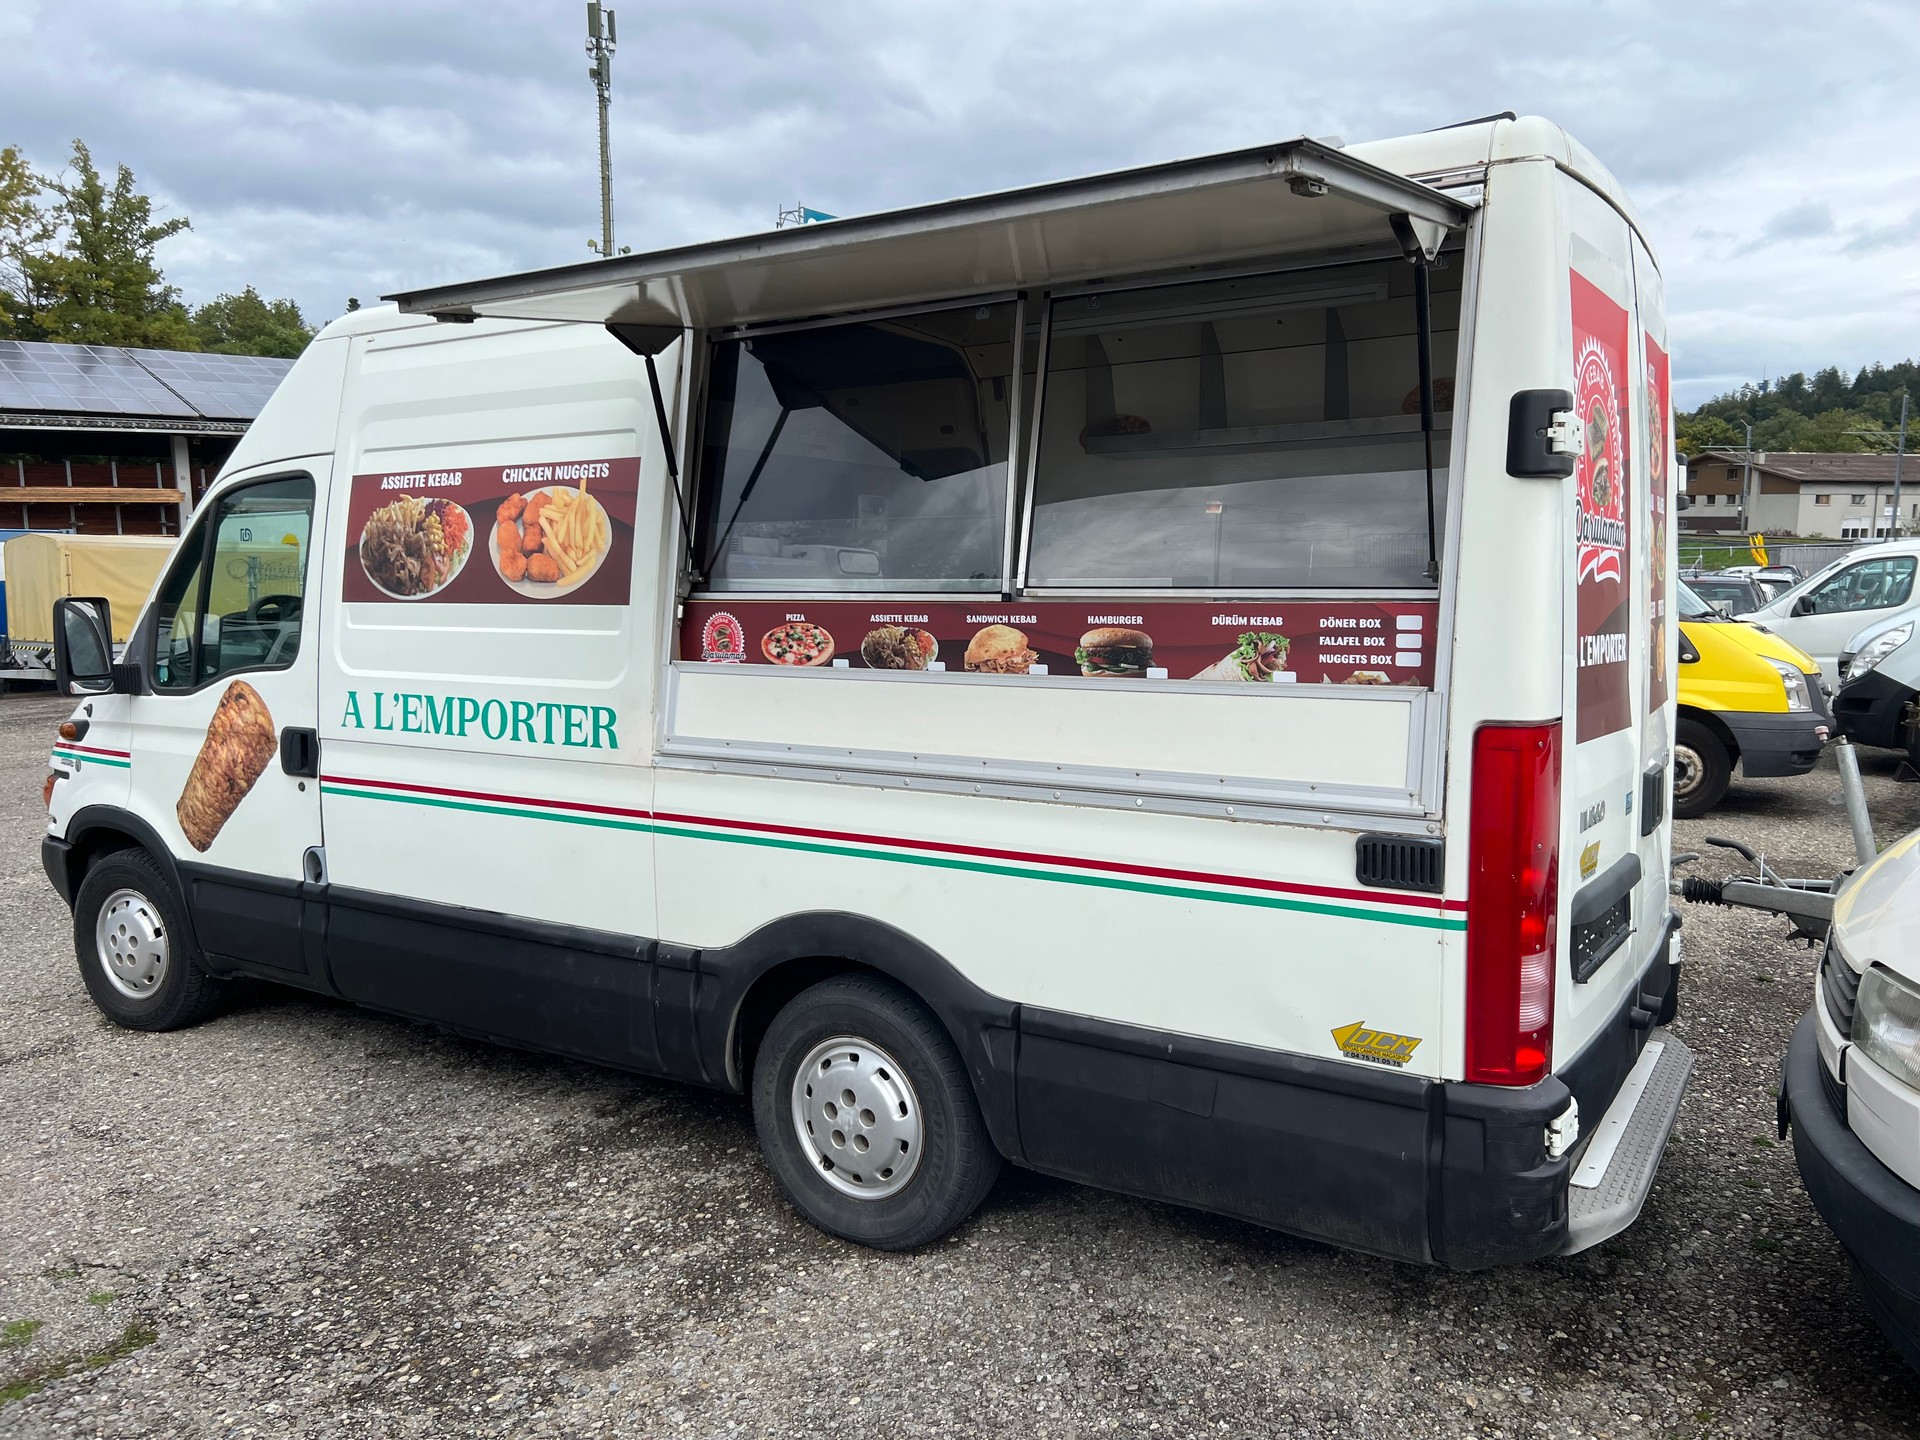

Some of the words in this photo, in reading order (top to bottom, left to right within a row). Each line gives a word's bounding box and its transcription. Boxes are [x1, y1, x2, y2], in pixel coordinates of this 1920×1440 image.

[502, 466, 551, 483] CHICKEN
[554, 462, 610, 480] NUGGETS
[381, 473, 426, 490] ASSIETTE
[427, 471, 463, 487] KEBAB
[785, 613, 806, 622] PIZZA
[869, 614, 903, 624] ASSIETTE
[904, 614, 929, 624] KEBAB
[966, 614, 1009, 624] SANDWICH
[1010, 615, 1037, 624] KEBAB
[1087, 615, 1144, 625] HAMBURGER
[1211, 614, 1248, 626] DÜRÜM
[1250, 616, 1283, 627] KEBAB
[1319, 616, 1357, 629] DÖNER
[1359, 618, 1382, 629] BOX
[1319, 635, 1361, 647] FALAFEL
[1363, 636, 1386, 647] BOX
[1580, 633, 1627, 667] L'EMPORTER
[1318, 653, 1368, 665] NUGGETS
[1370, 654, 1393, 666] BOX
[341, 691, 365, 729] A
[373, 692, 620, 750] L'EMPORTER
[1348, 1028, 1421, 1055] DCM
